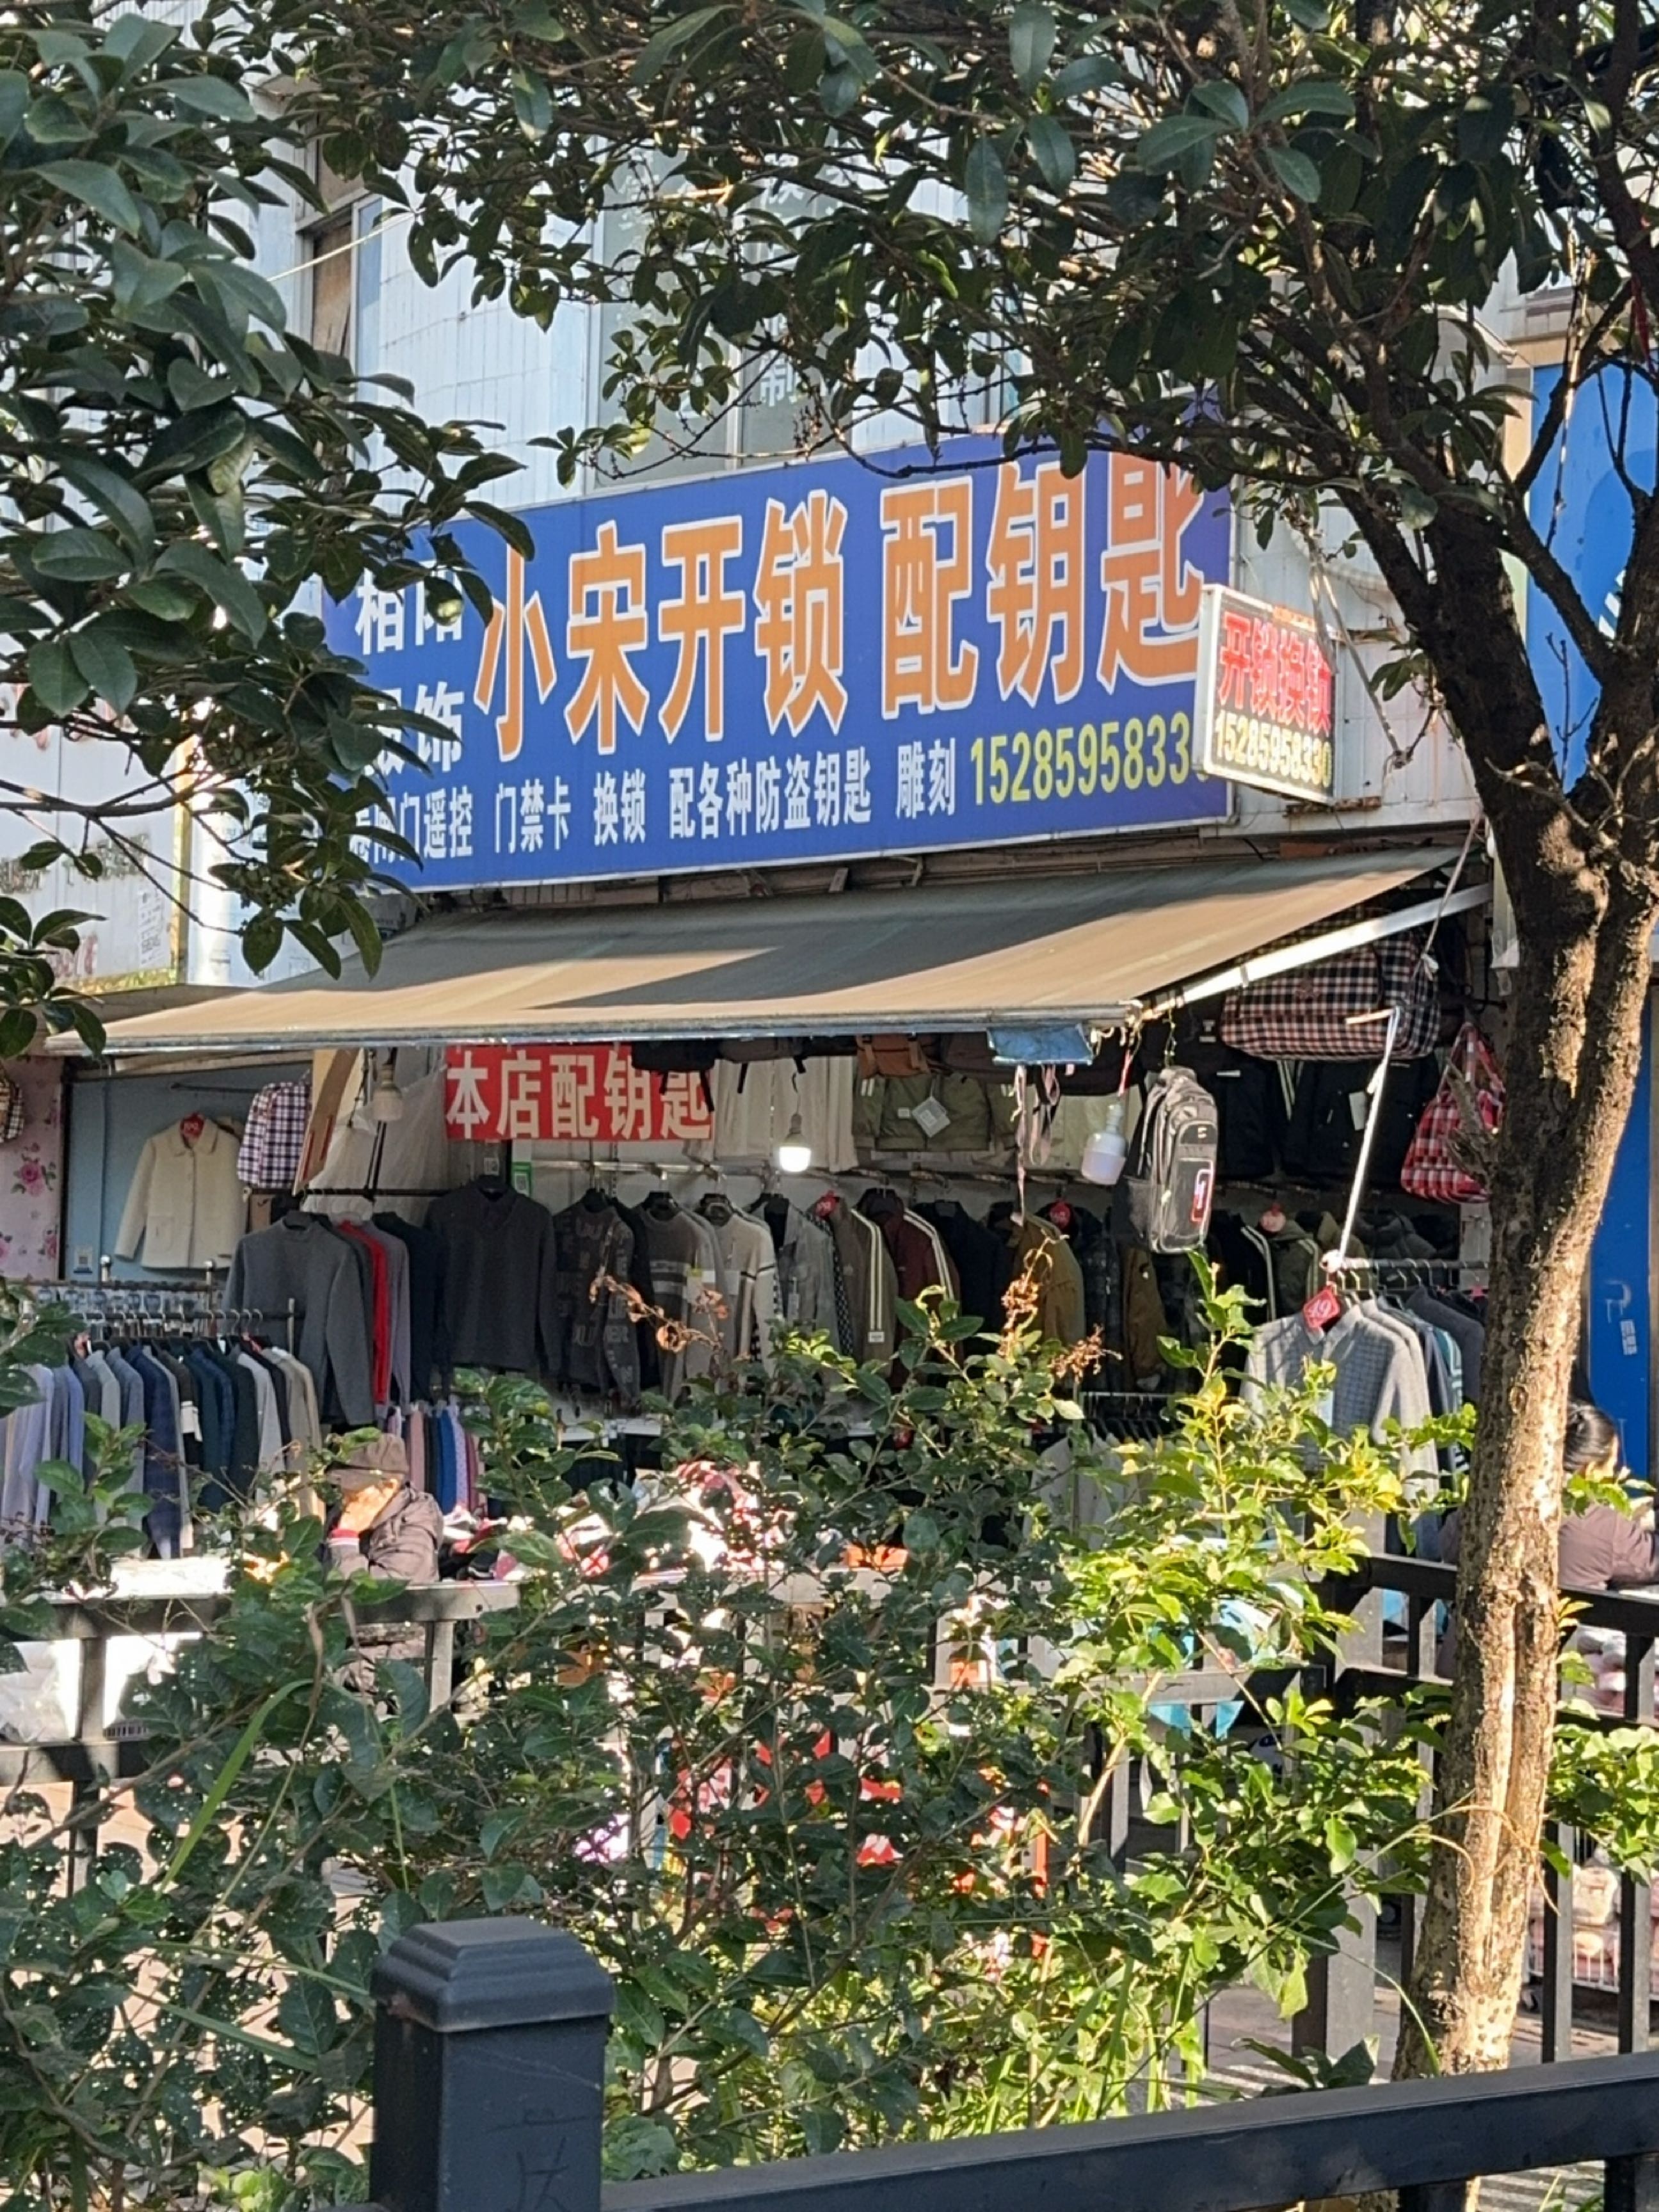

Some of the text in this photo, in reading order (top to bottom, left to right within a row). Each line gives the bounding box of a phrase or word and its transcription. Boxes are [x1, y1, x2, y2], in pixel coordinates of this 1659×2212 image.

[474, 439, 1204, 762] 小宋开锁 配钥匙
[1219, 611, 1331, 737] 开锁换锁
[495, 775, 571, 854] 门禁卡
[593, 768, 646, 846] 换锁
[669, 746, 871, 839] 配各种防盗钥匙
[896, 737, 956, 819] 雕刻
[971, 711, 1208, 805] 1528595833
[446, 1050, 710, 1139] 本店配钥匙
